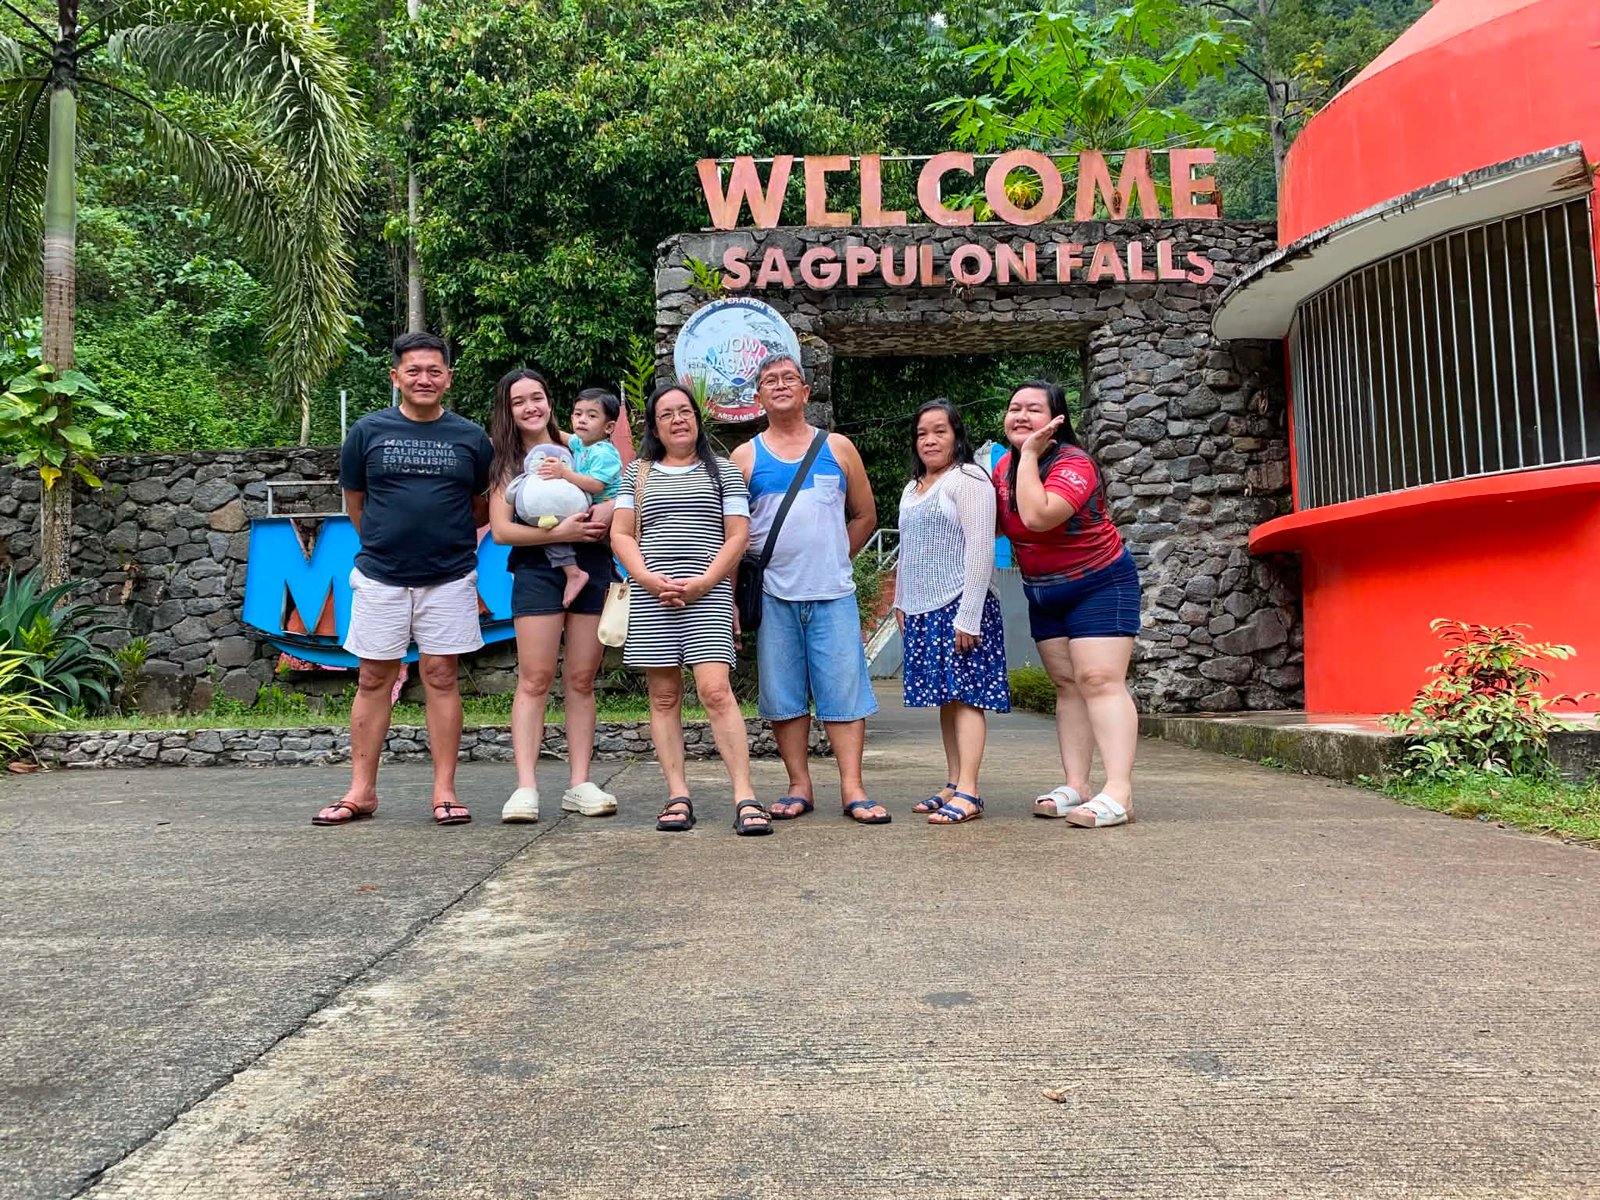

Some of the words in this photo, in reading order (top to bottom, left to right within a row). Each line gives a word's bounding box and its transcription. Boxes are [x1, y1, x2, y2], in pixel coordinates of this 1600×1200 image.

[697, 149, 1221, 230] WELCOME
[722, 242, 1037, 291] SAGPULON
[1056, 240, 1214, 285] FALLS
[717, 336, 759, 354] WOW
[708, 355, 762, 375] JASAA
[383, 447, 456, 457] CALIFORNIA
[384, 439, 441, 449] MACBETH
